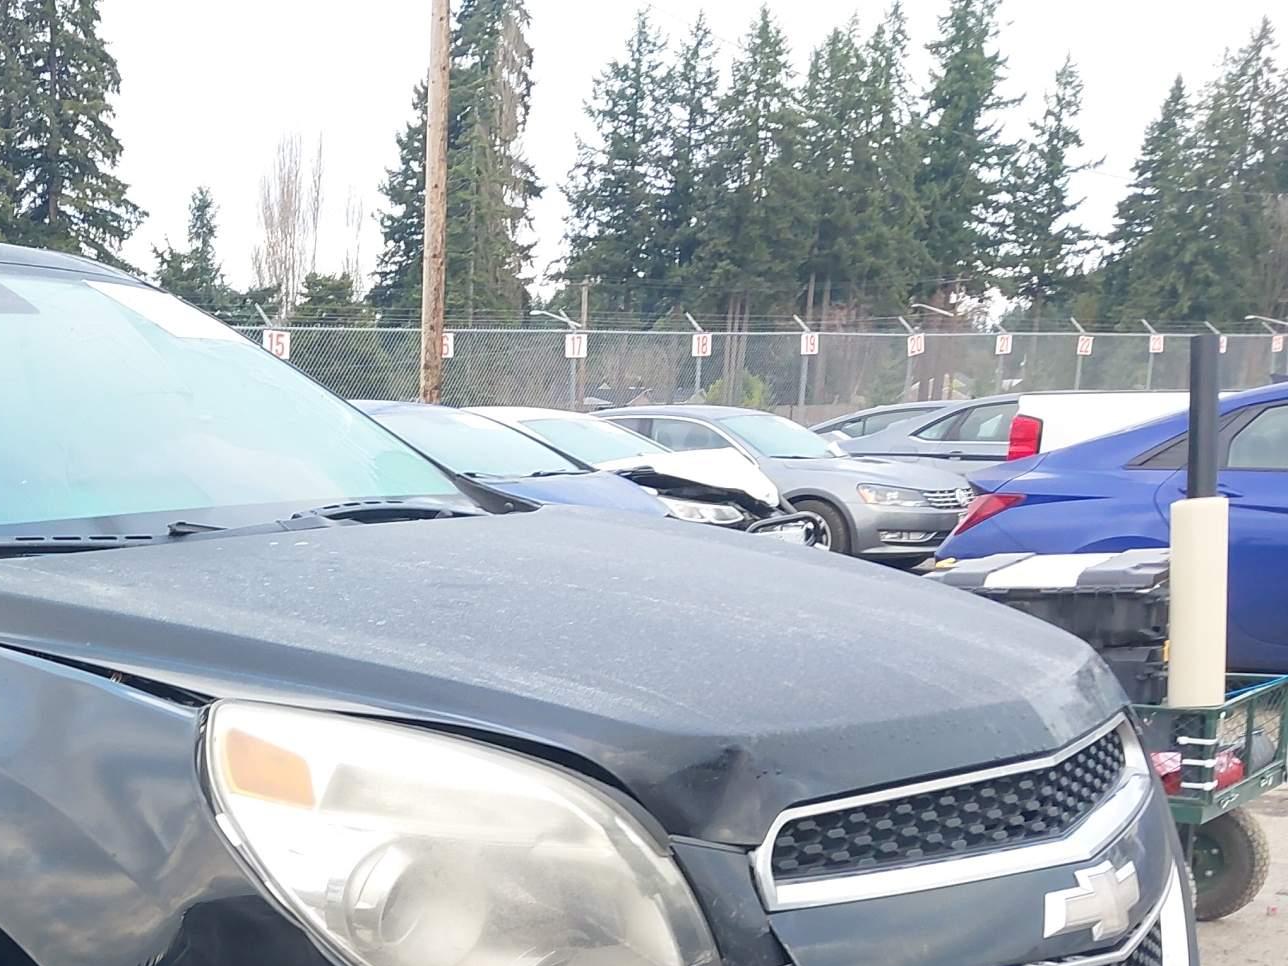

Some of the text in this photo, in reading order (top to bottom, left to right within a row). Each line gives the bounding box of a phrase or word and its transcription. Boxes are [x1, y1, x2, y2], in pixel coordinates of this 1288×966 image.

[269, 330, 285, 357] 15
[442, 335, 449, 356] 6
[571, 336, 582, 355] 17
[697, 336, 707, 355] 18
[805, 335, 816, 353] 19
[910, 336, 923, 354] 20
[999, 336, 1010, 353] 21
